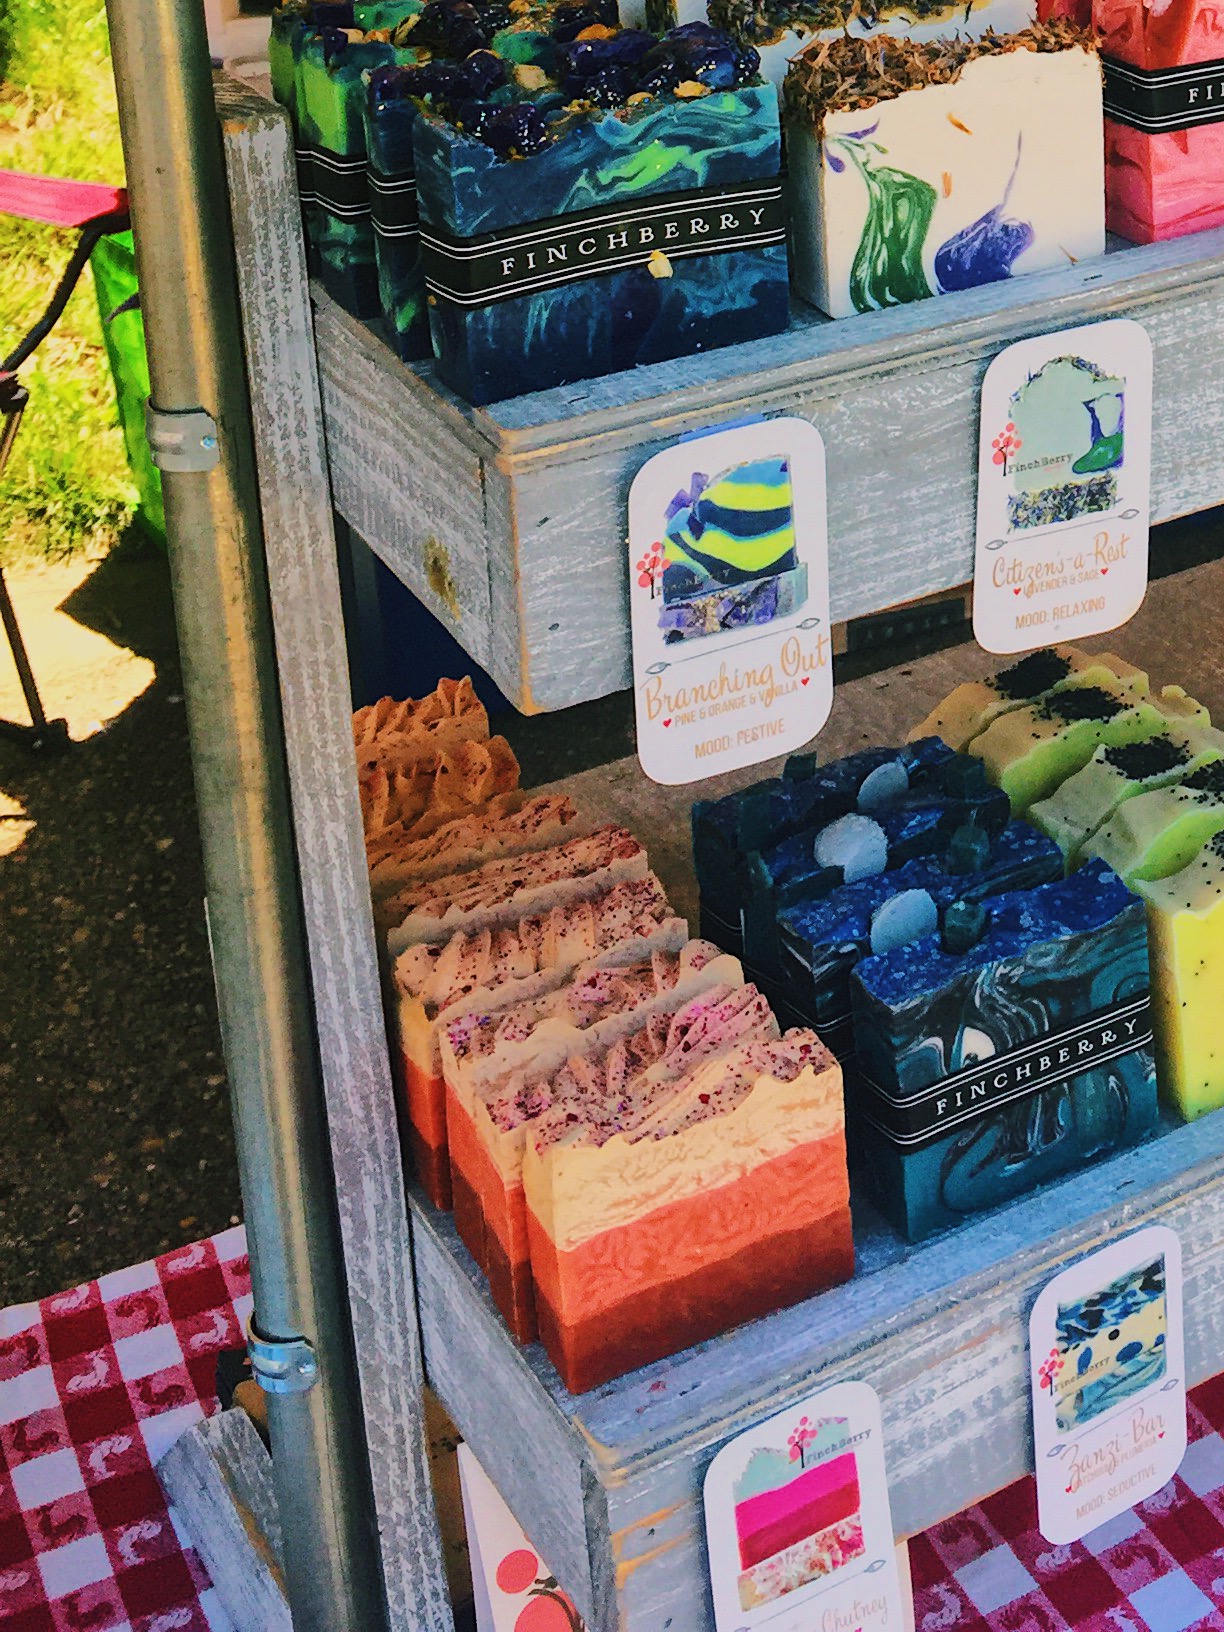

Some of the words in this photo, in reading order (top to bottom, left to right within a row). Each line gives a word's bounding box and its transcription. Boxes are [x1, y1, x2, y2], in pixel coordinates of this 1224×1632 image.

[500, 208, 765, 276] FINCHBERRY
[1008, 453, 1073, 474] FinchBerry
[1078, 569, 1100, 583] SAGE
[1053, 596, 1106, 620] RELAXING
[640, 661, 778, 720] Branching
[780, 633, 829, 676] Out
[674, 710, 697, 727] PINE
[708, 695, 747, 717] ORANGE
[935, 1018, 1138, 1116] FINCHBERRY
[822, 1596, 888, 1632] Chutney
